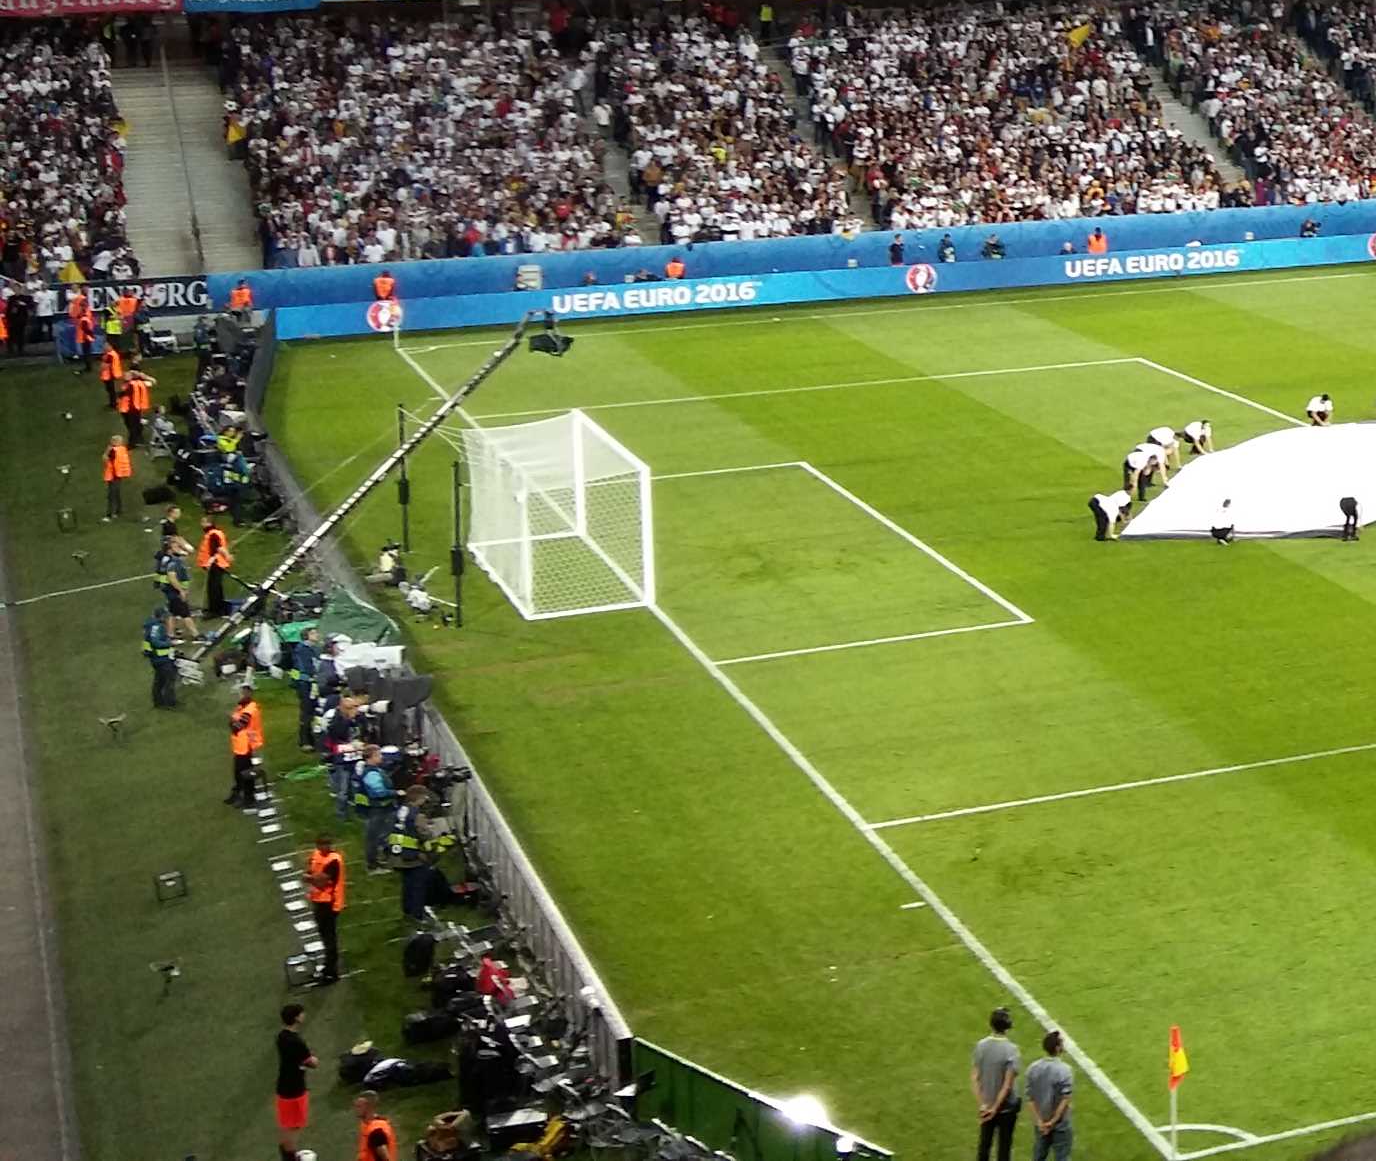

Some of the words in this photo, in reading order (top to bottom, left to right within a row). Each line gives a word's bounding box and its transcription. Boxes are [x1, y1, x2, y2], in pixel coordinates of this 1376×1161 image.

[1064, 260, 1123, 278] UEFA
[1125, 255, 1184, 273] EURO
[1186, 251, 1240, 269] 2016
[552, 290, 621, 314] UEFA
[623, 285, 691, 310] EURO
[695, 281, 757, 303] 2016
